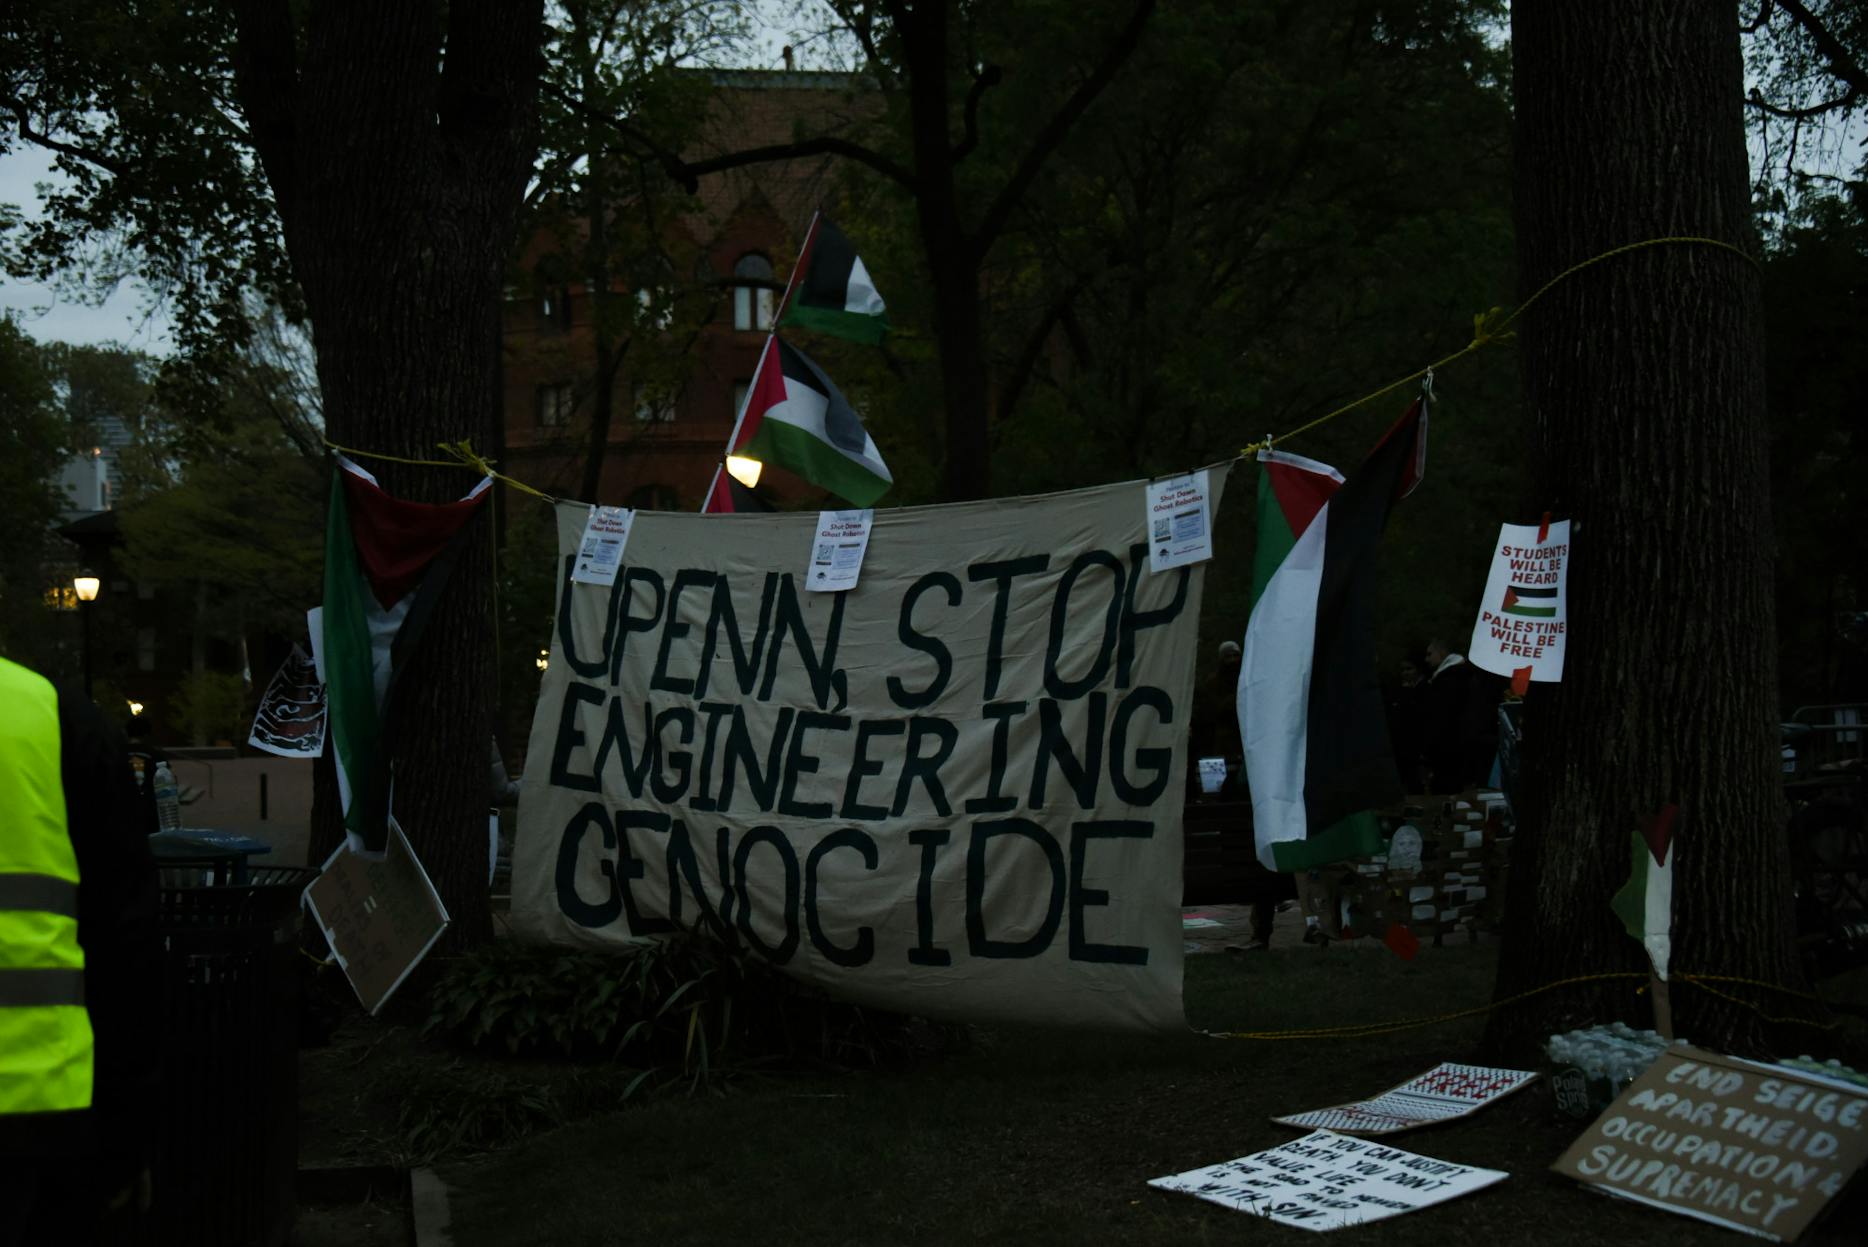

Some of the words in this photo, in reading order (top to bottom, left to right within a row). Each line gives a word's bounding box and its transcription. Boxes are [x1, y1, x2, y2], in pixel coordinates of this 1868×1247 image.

[1501, 544, 1567, 559] STUDENTS
[1510, 559, 1545, 572] WILL
[1549, 558, 1561, 570] BE
[1511, 571, 1559, 584] HEARD
[887, 544, 1191, 709] STOP
[1481, 611, 1565, 634] PALESTINE
[1490, 627, 1531, 645] WILL
[1536, 635, 1556, 647] BE
[1500, 643, 1542, 658] FREE
[550, 682, 1173, 820] ENGINEERING
[556, 803, 1154, 967] GENOCIDE
[1664, 1062, 1745, 1097] END
[1254, 1153, 1315, 1173] VALUE
[1314, 1170, 1367, 1186] LIFE
[1306, 1133, 1332, 1142] IF
[1328, 1139, 1368, 1152] YOU
[1364, 1147, 1407, 1161] CAN
[1400, 1156, 1475, 1179] JUSTIFY
[1347, 1160, 1390, 1175] YOU
[1600, 1115, 1819, 1192] OCCUPATION
[1816, 1169, 1844, 1198] &
[1198, 1182, 1271, 1202] WITH
[1576, 1144, 1800, 1227] SUPREMACY
